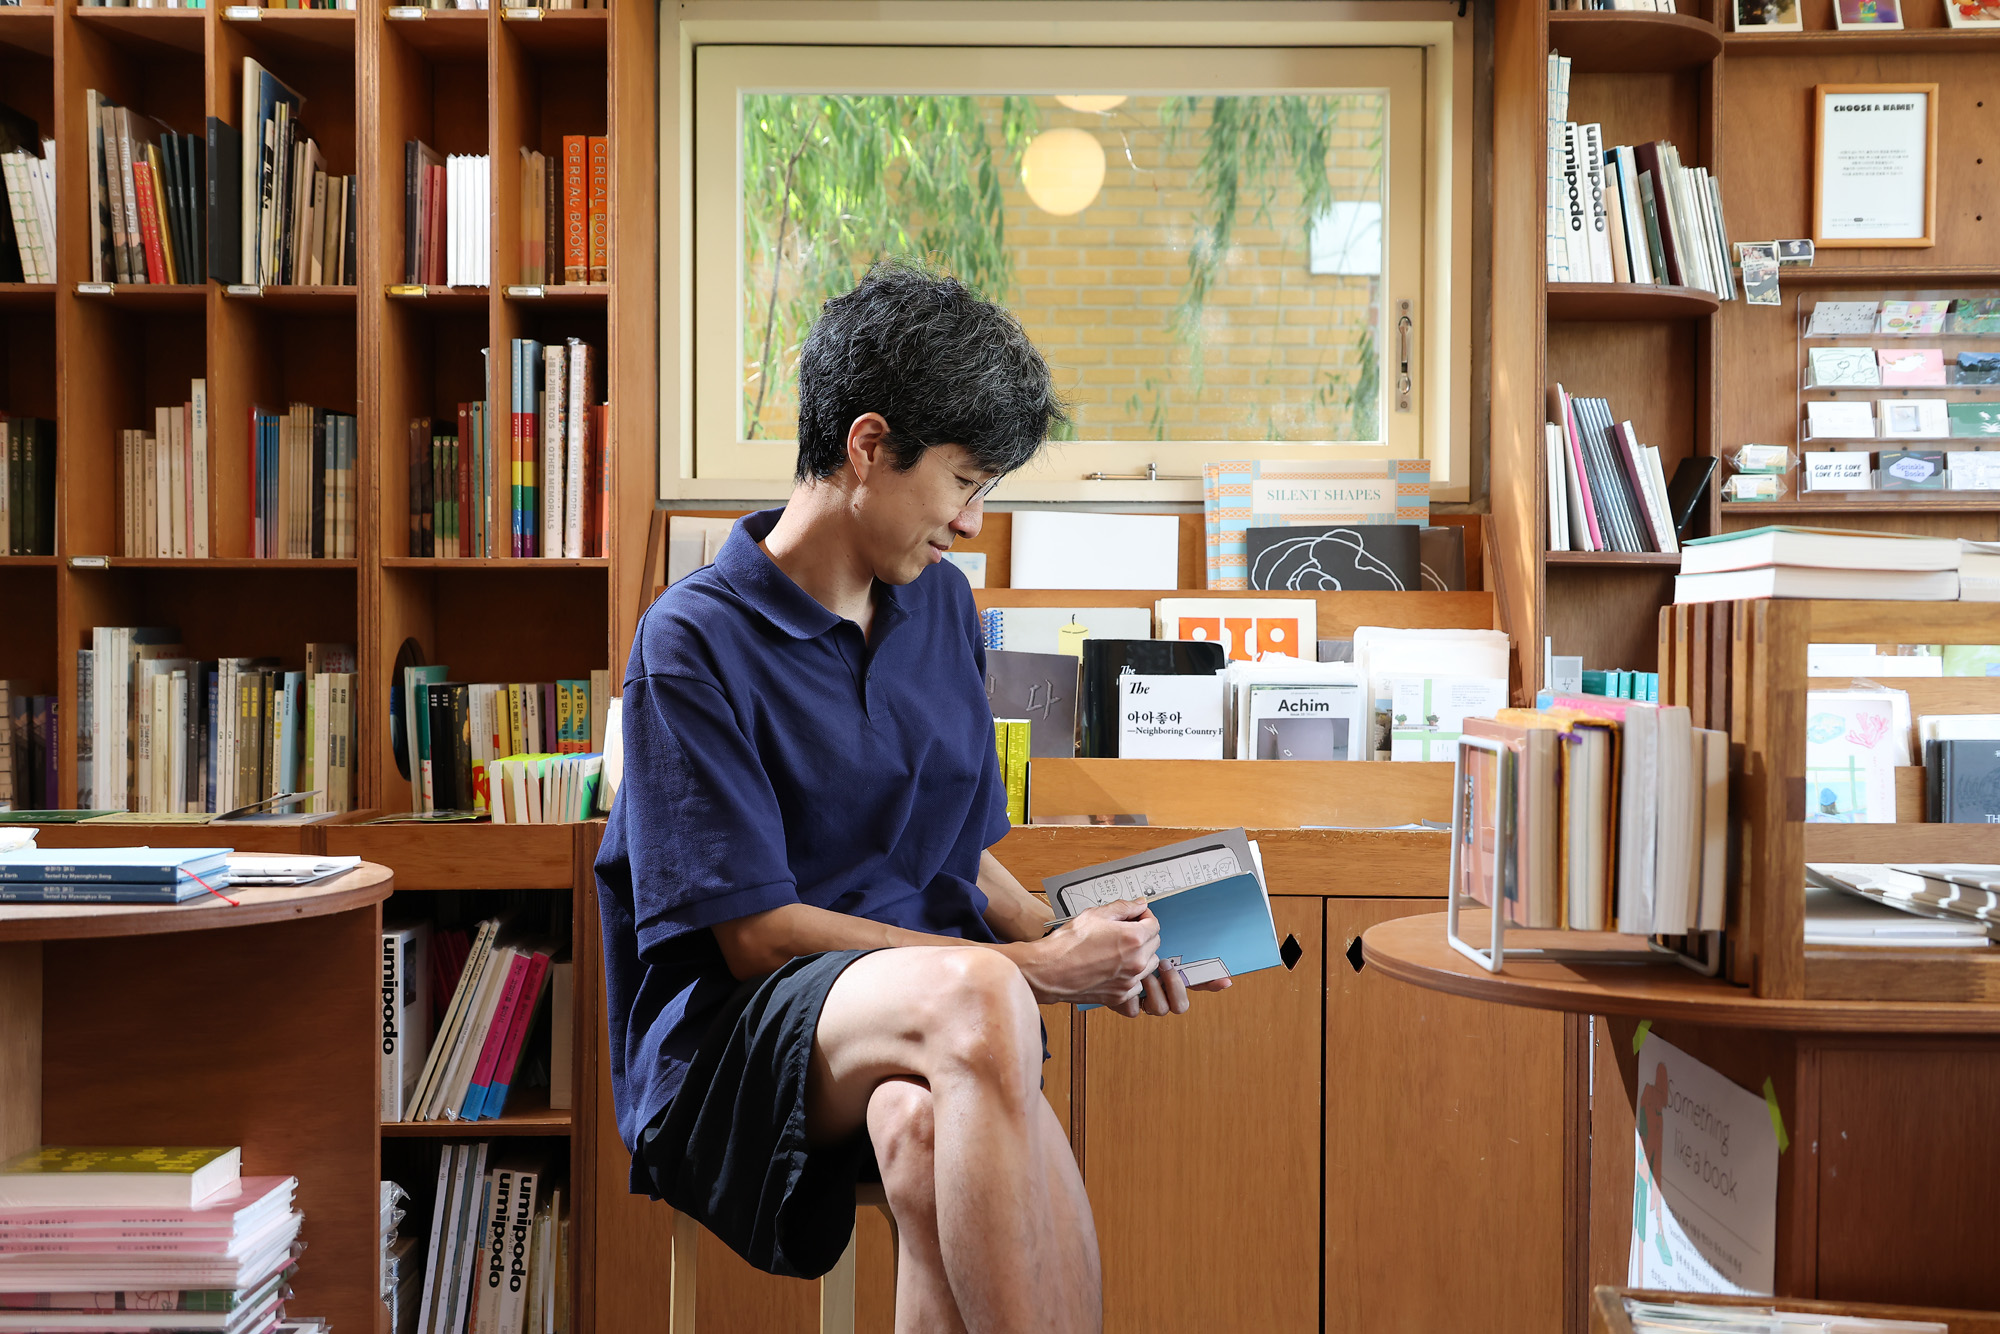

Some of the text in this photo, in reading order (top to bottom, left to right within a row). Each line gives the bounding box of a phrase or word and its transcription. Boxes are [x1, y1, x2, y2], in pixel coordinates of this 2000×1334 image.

[1834, 104, 1871, 112] CHOOSE
[106, 137, 124, 233] Killing and Dying
[120, 137, 138, 233] Killing and Dying
[1586, 126, 1607, 232] umipodo
[569, 143, 582, 258] CEREAL BOOK
[594, 144, 606, 258] CEREAL BOOK
[571, 407, 580, 428] TOYS
[547, 446, 555, 475] OTHER
[570, 445, 578, 475] OTHER
[1896, 464, 1924, 472] Sprinkle
[1904, 470, 1925, 478] Books
[547, 477, 555, 530] MEMORIALS
[570, 477, 578, 528] MEMORIALS
[1267, 489, 1381, 501] SILENT SHAPES
[1120, 665, 1136, 675] The
[1129, 682, 1150, 694] The
[561, 702, 568, 714] 없는
[577, 702, 584, 715] 없는
[1128, 710, 1182, 724] 아아좋아
[1278, 698, 1330, 712] Achim
[1185, 727, 1217, 737] Country
[382, 938, 398, 1054] umipodo
[1667, 1079, 1730, 1157] Something
[1674, 1128, 1738, 1203] like a book
[489, 1173, 512, 1288] umipodo
[510, 1176, 532, 1292] umipodo
